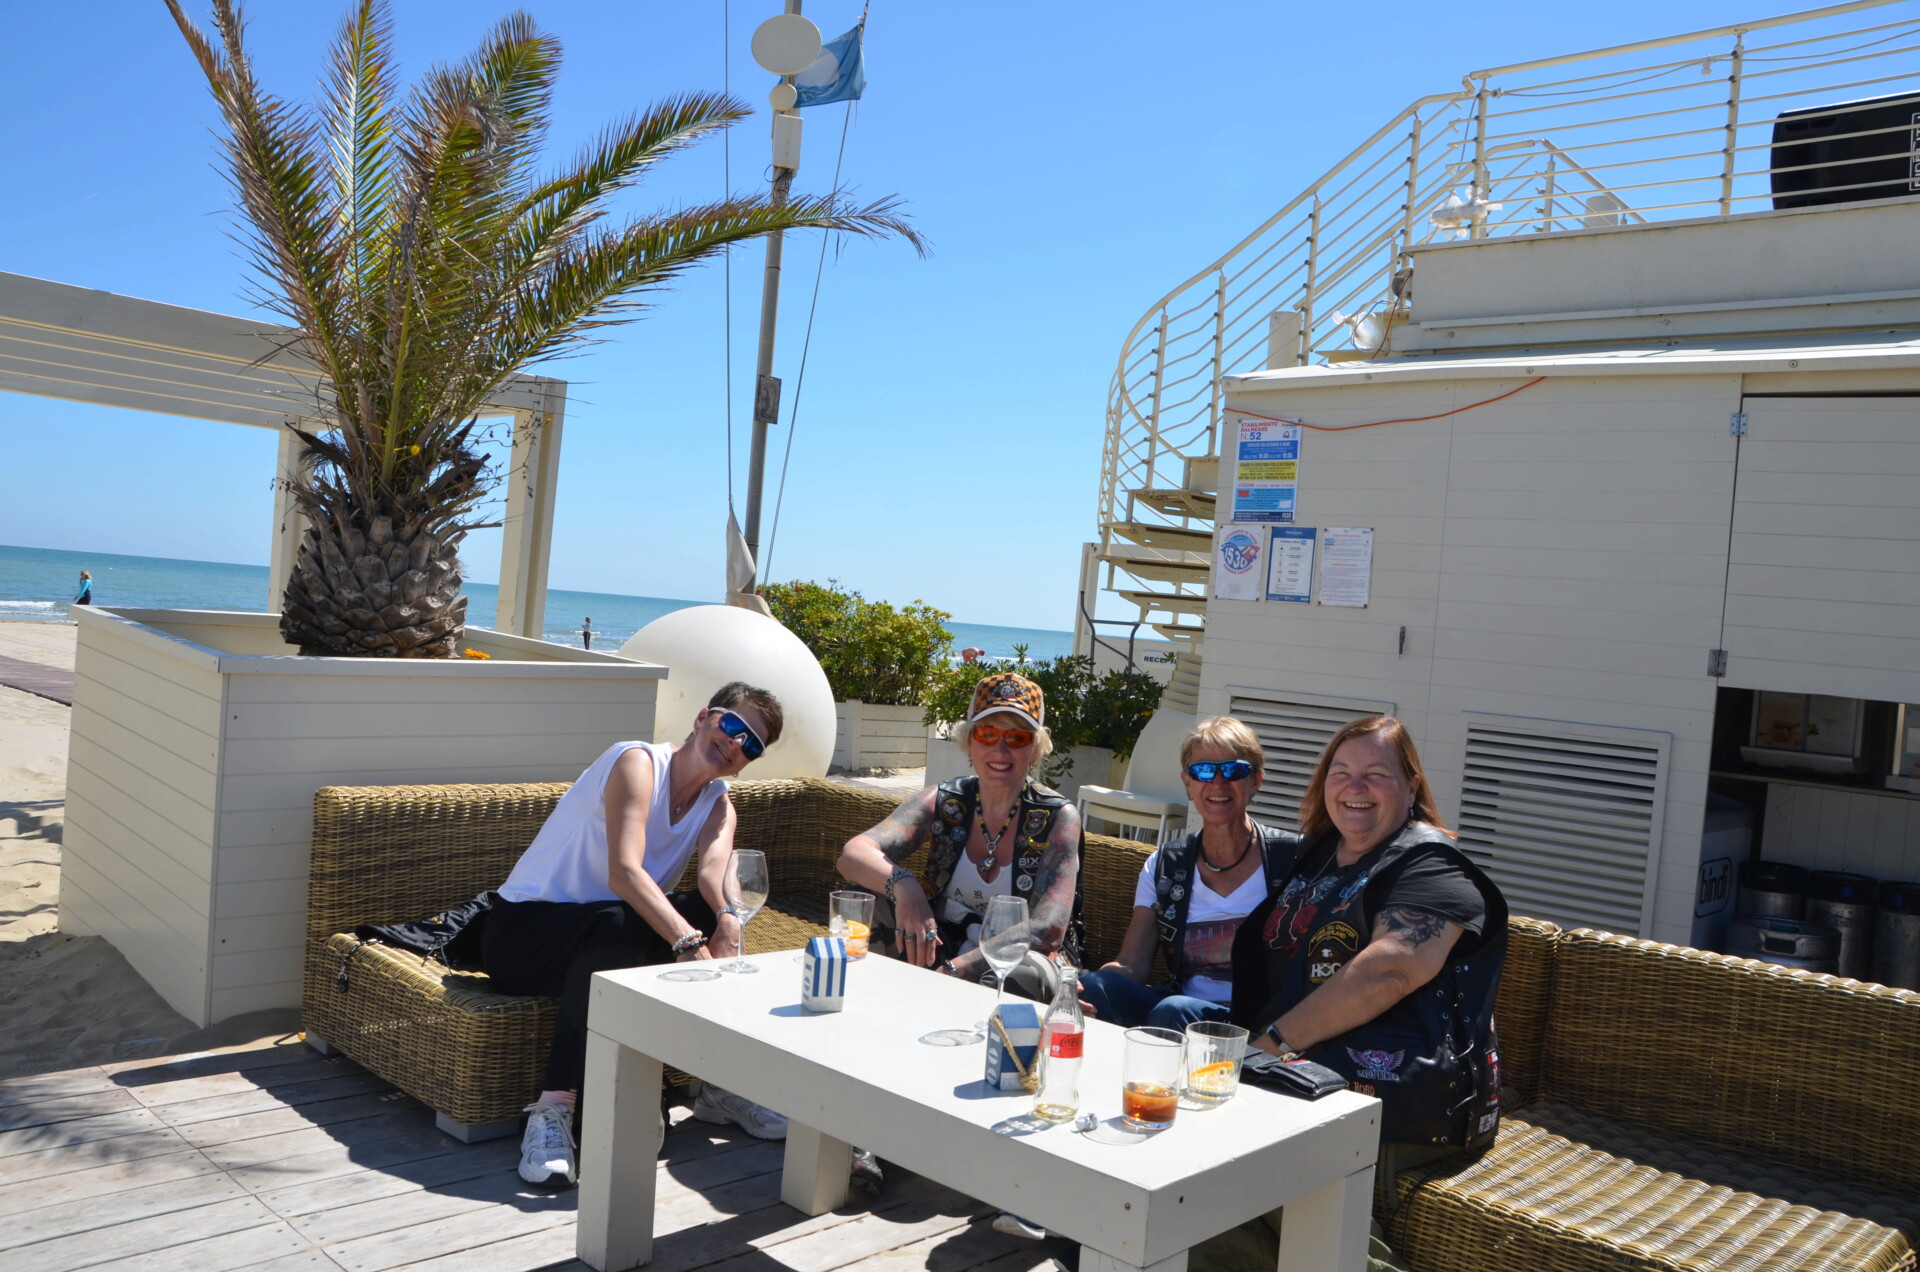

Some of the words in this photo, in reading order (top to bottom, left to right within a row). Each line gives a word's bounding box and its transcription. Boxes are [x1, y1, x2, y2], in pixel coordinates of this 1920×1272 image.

[1249, 431, 1262, 440] 52
[1224, 547, 1248, 568] 1530
[1699, 864, 1729, 904] bindi
[1335, 924, 1356, 938] CHAPTER
